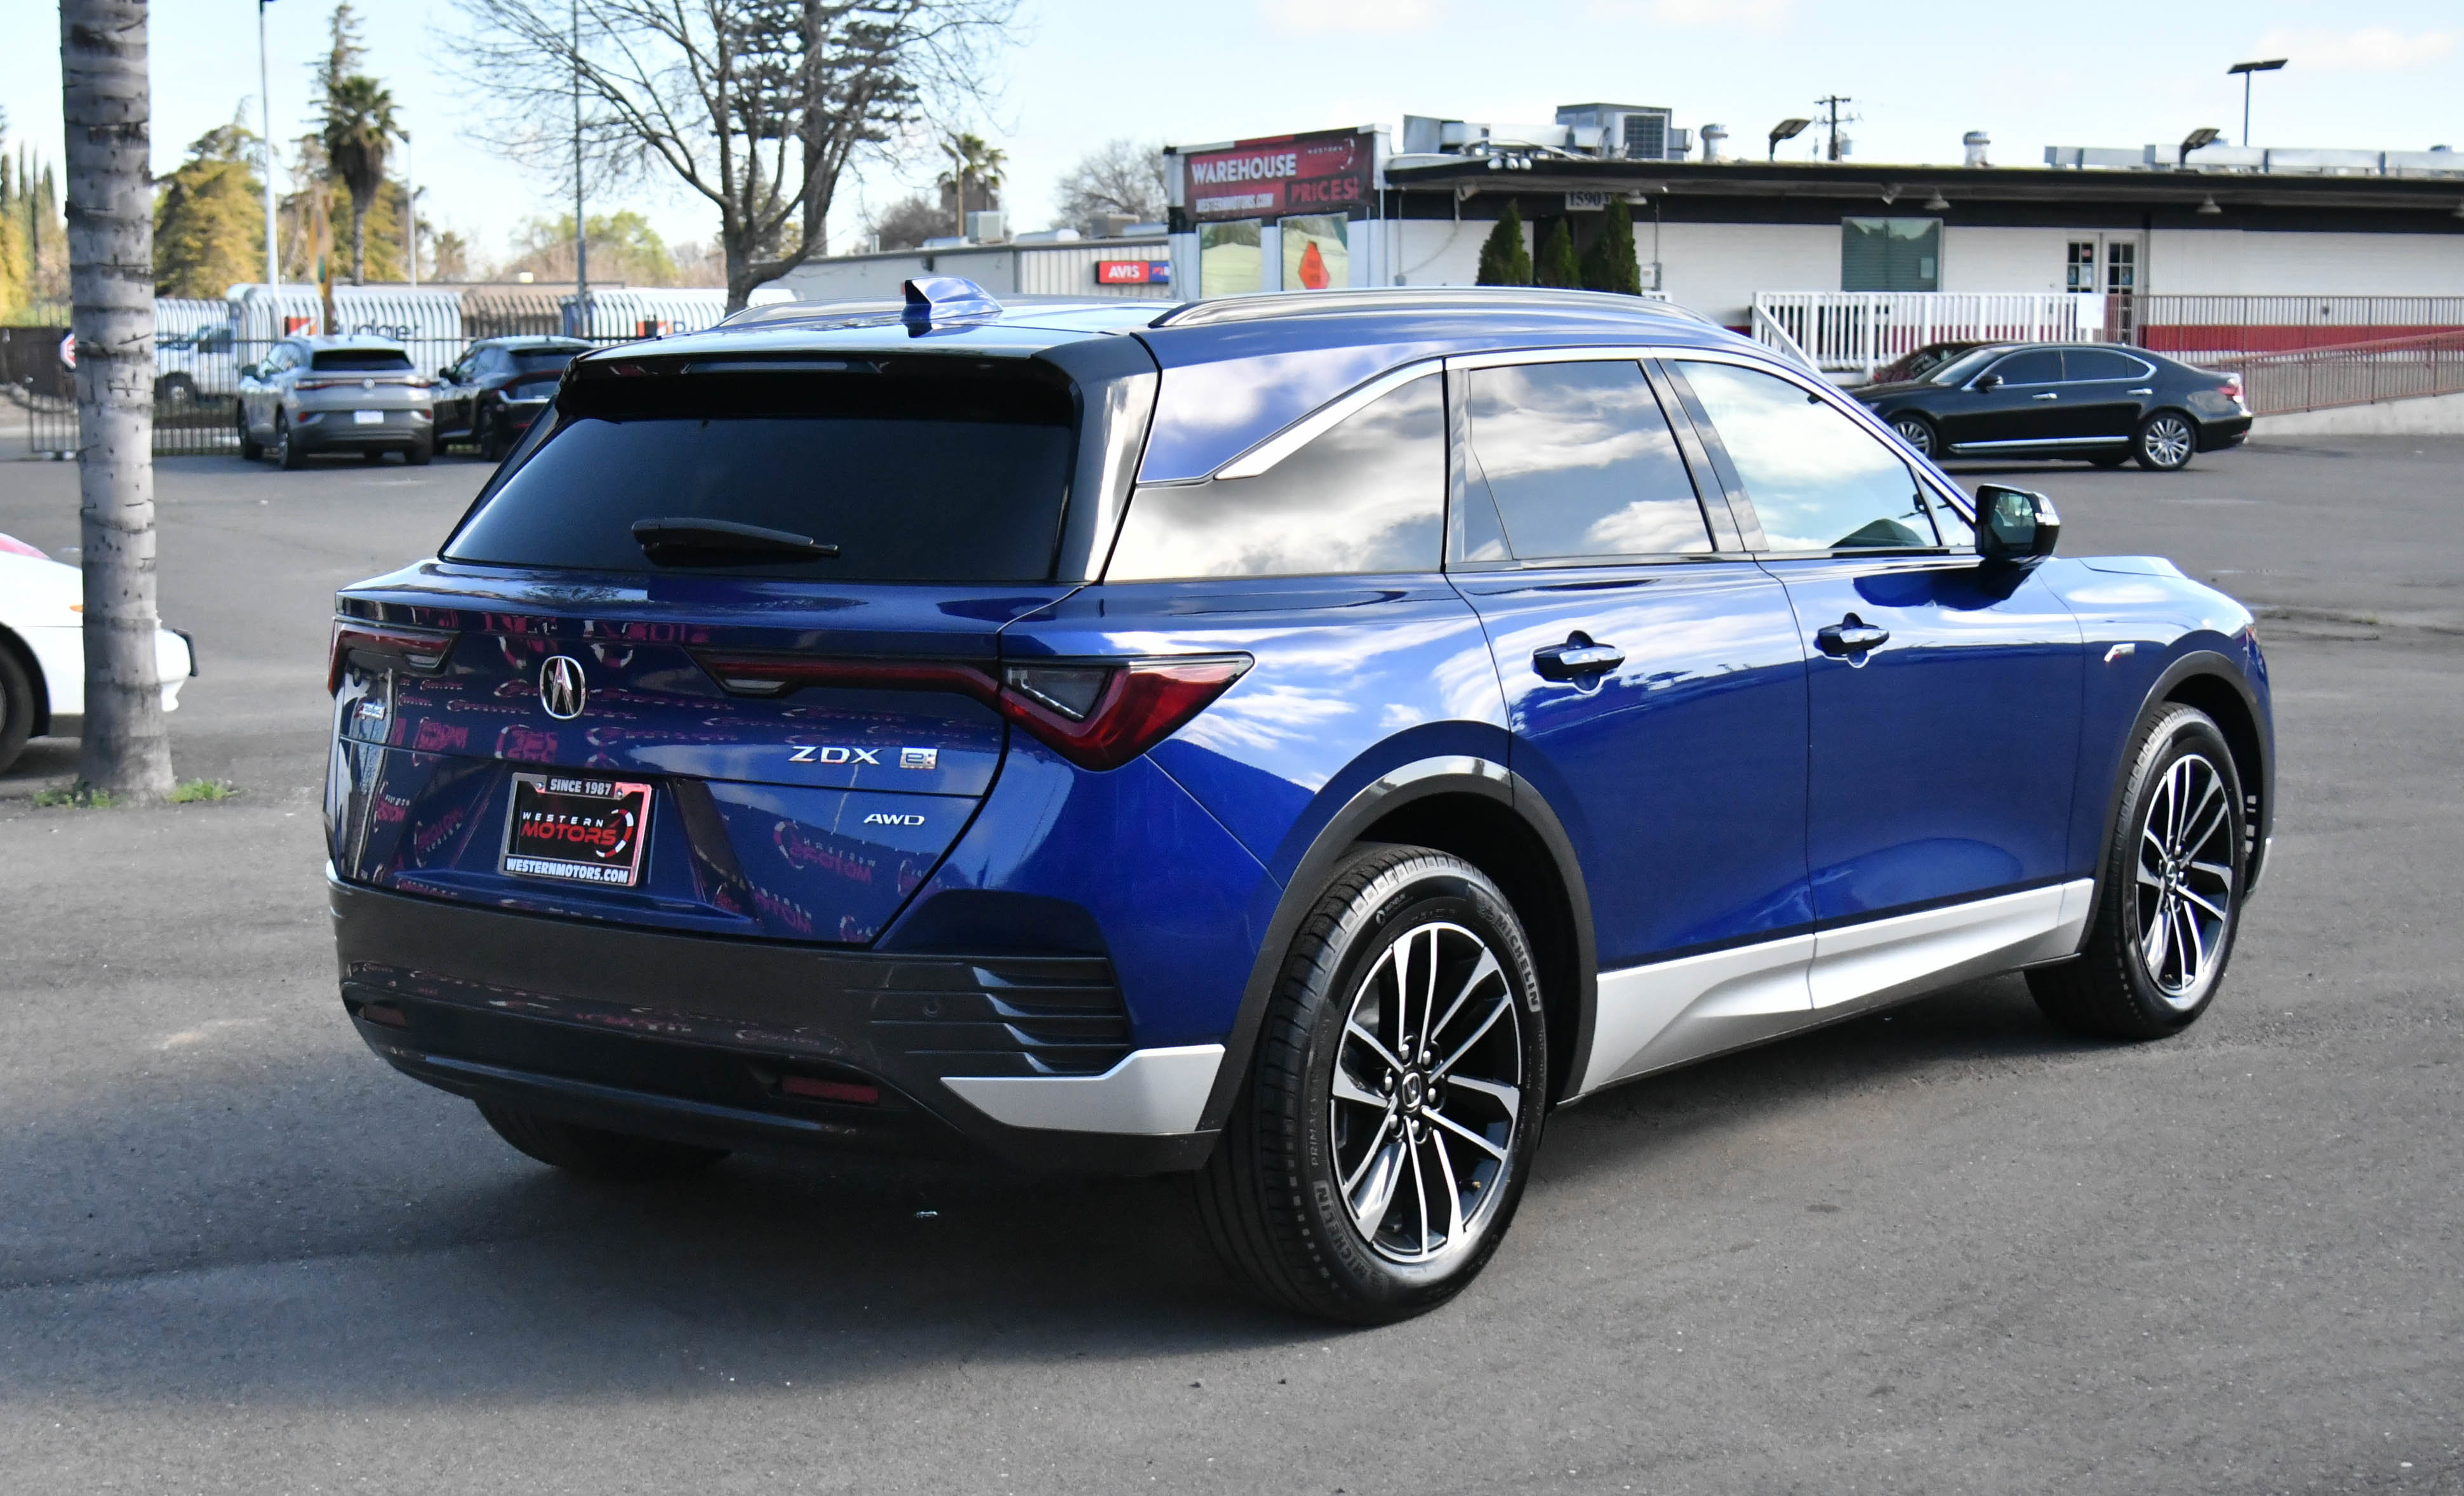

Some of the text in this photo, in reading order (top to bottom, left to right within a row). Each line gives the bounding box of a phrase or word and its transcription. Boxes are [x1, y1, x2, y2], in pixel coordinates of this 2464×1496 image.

[1191, 153, 1297, 185] WAREHOUSE
[1290, 176, 1359, 202] PRICES!
[1569, 192, 1602, 206] 1590
[1108, 265, 1141, 279] AVIS
[787, 746, 882, 765] ZDX
[550, 778, 611, 795] SINCE 1987
[523, 811, 604, 828] WESTERN
[863, 814, 925, 826] AWD
[520, 821, 617, 846] MOTORS
[506, 857, 629, 884] WESTERNMOTORS.COM
[1496, 914, 1539, 1007] MICHELIN
[1316, 1187, 1368, 1278] MICHELIN
